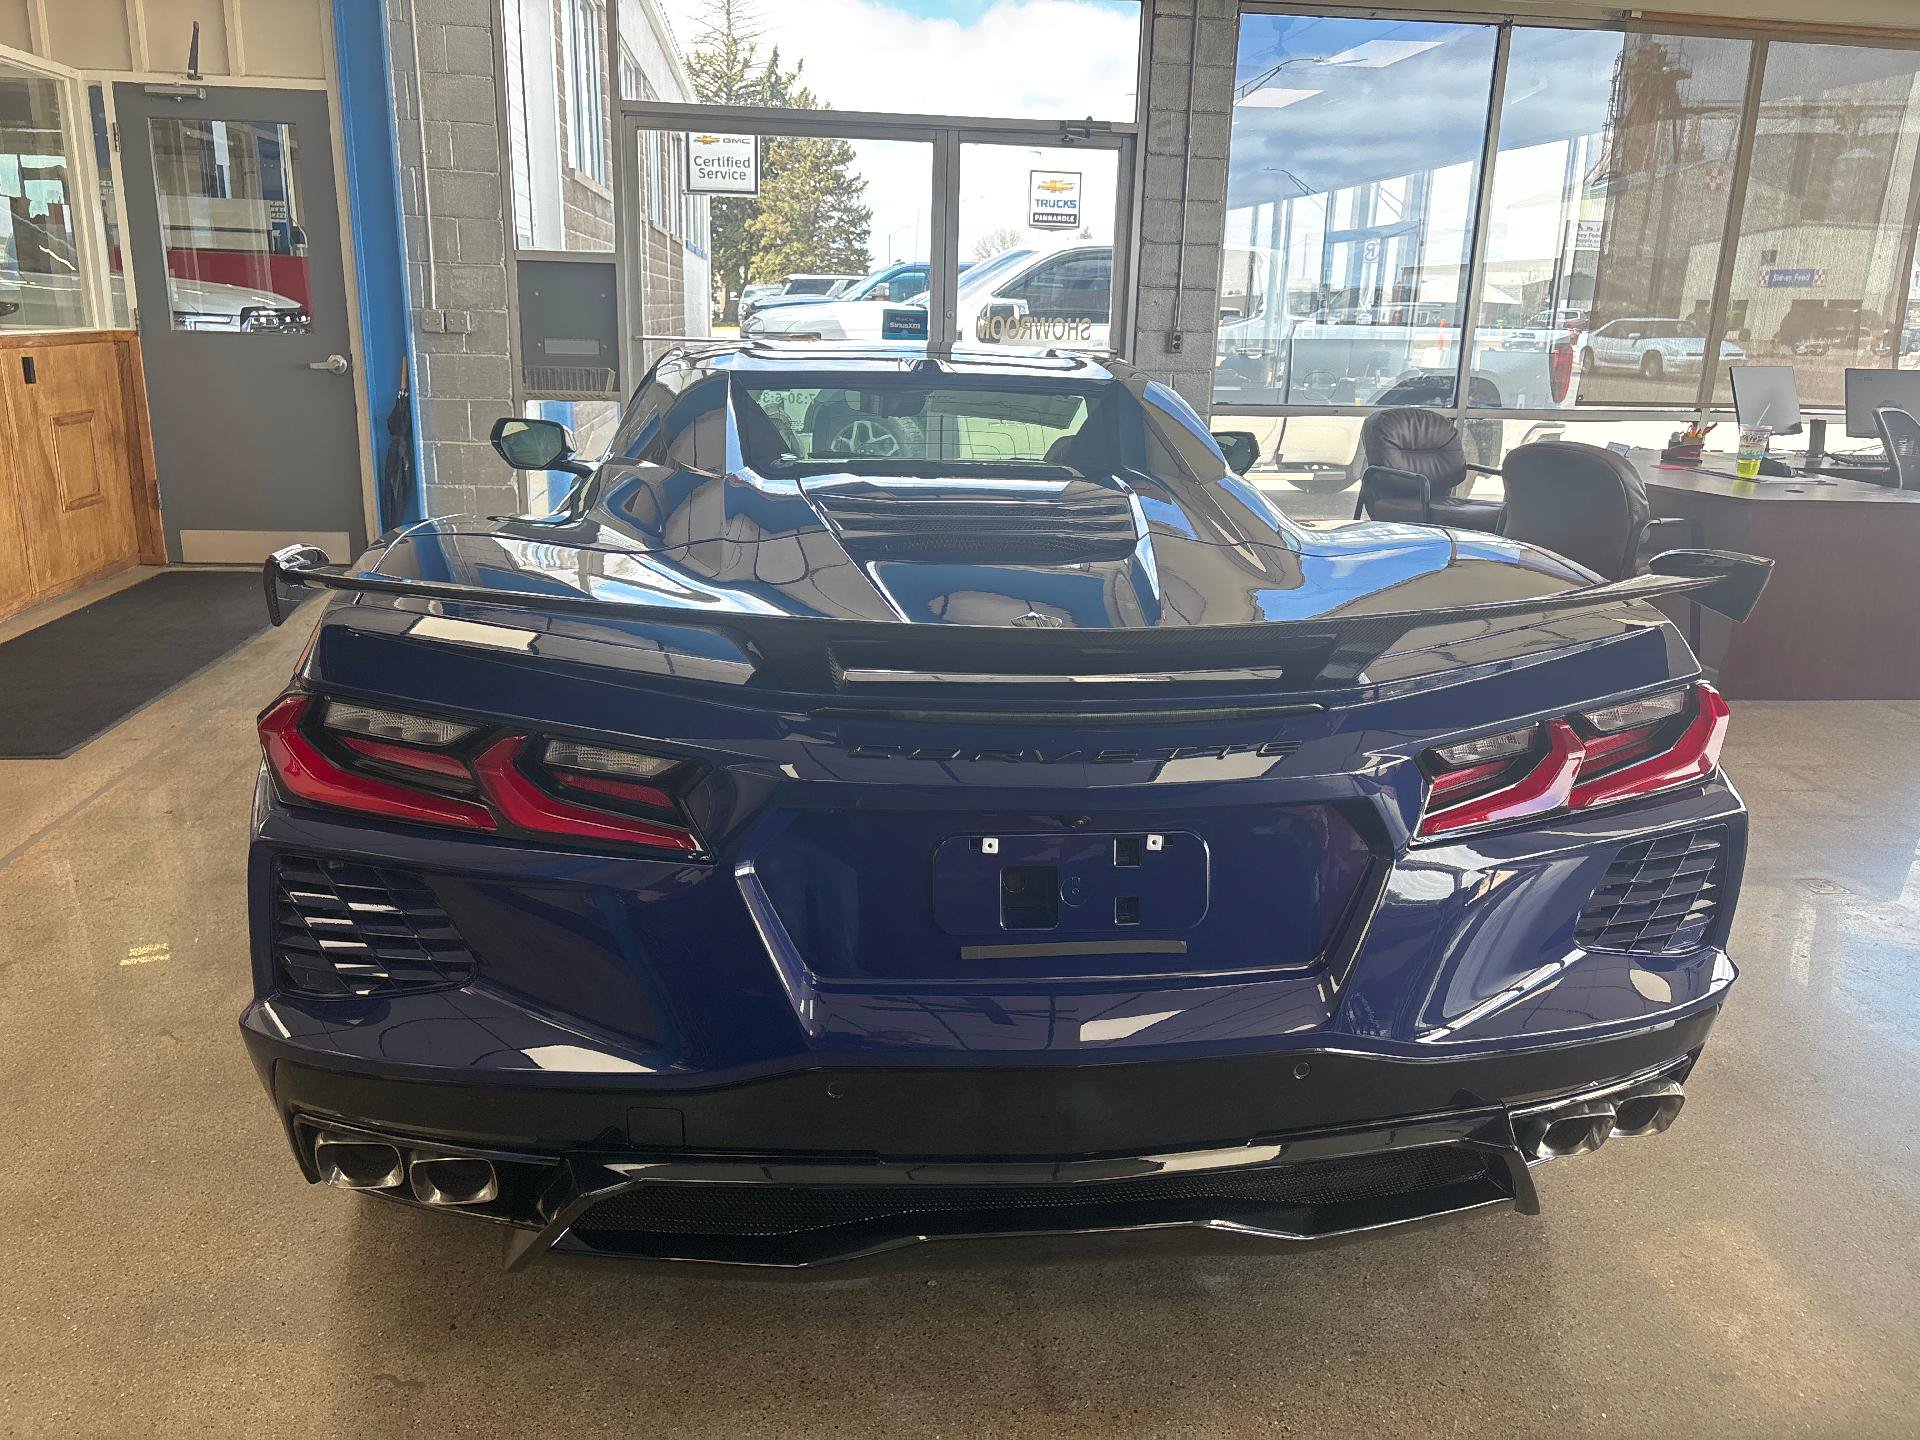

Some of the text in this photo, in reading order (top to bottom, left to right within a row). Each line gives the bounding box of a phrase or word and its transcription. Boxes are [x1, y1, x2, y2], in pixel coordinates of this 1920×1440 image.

[722, 137, 751, 145] GMC
[693, 155, 751, 169] Certified
[698, 168, 747, 181] Service
[1035, 198, 1077, 209] TRUCKS
[1033, 213, 1076, 223] PANHANDLE
[848, 740, 1303, 764] CORVETTE
